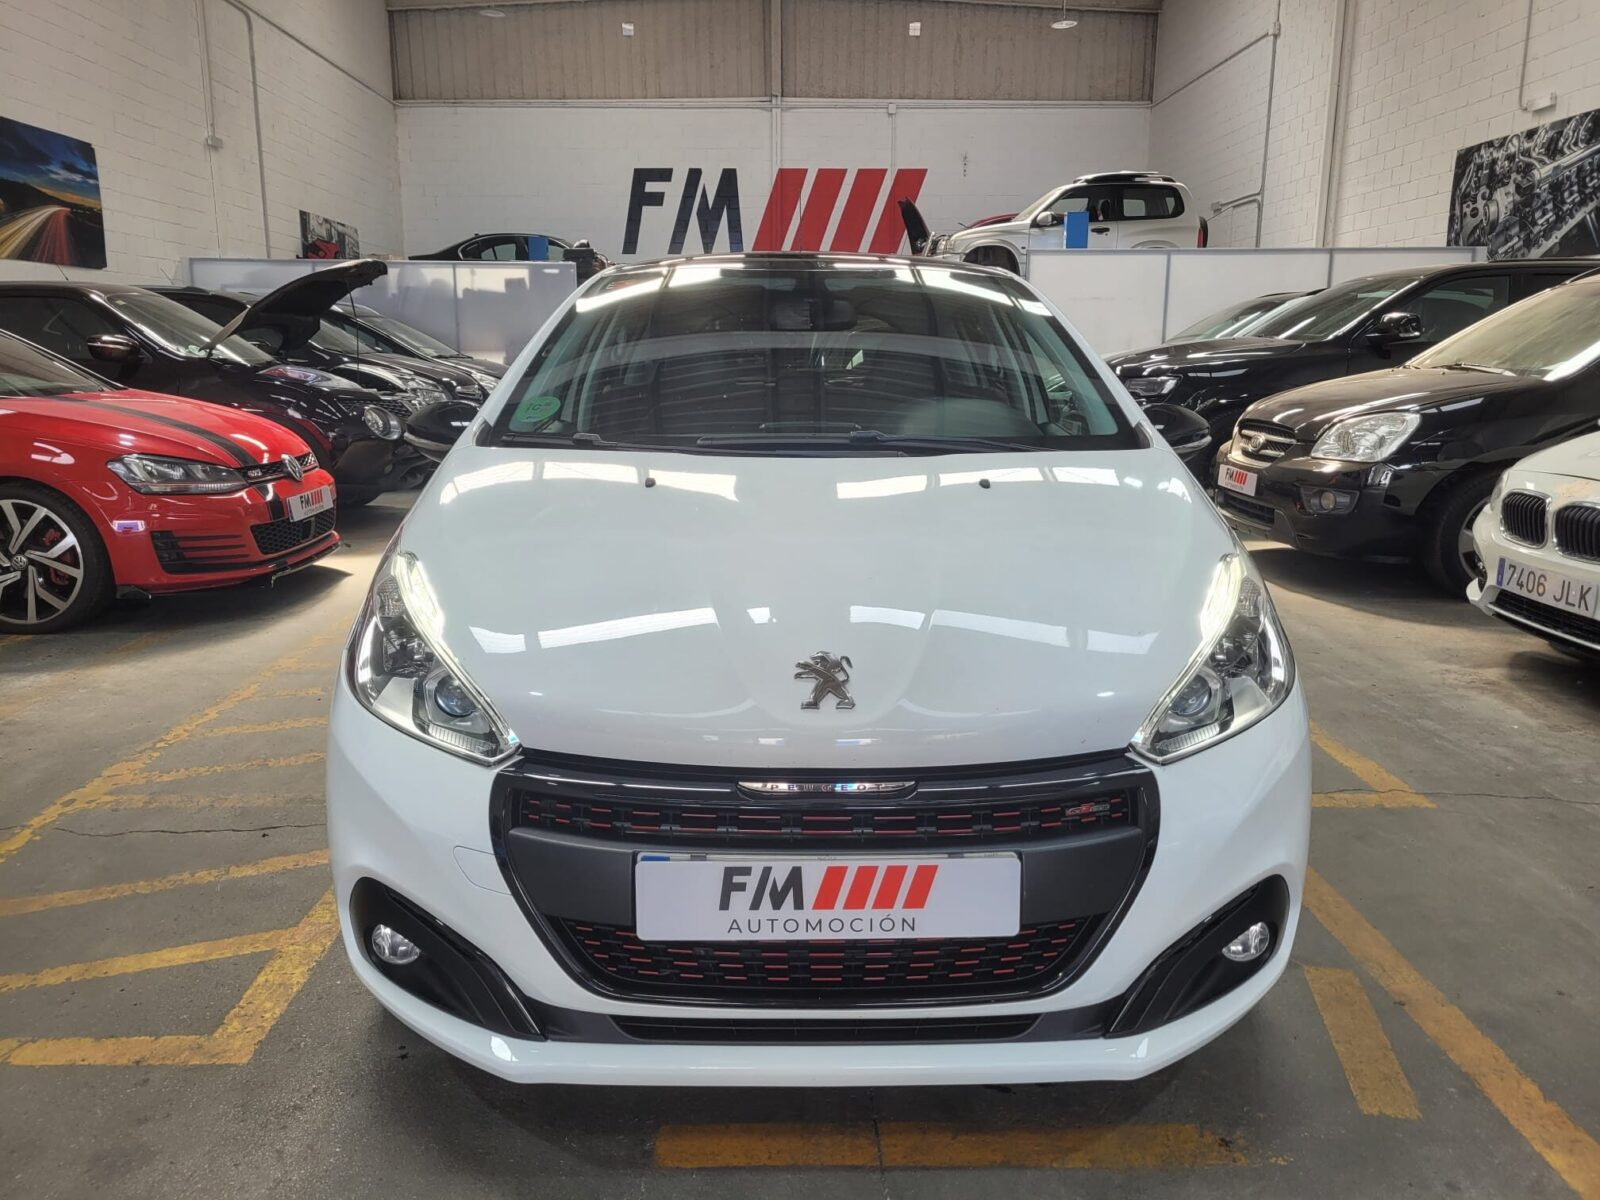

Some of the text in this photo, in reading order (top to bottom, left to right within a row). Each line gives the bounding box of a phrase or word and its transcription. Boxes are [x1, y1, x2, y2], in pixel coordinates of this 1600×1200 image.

[622, 168, 743, 254] FM
[300, 492, 311, 510] FM
[1506, 564, 1592, 611] 7406 JLK
[719, 866, 804, 911] FM
[727, 914, 916, 933] AUTOMOCIÓN
